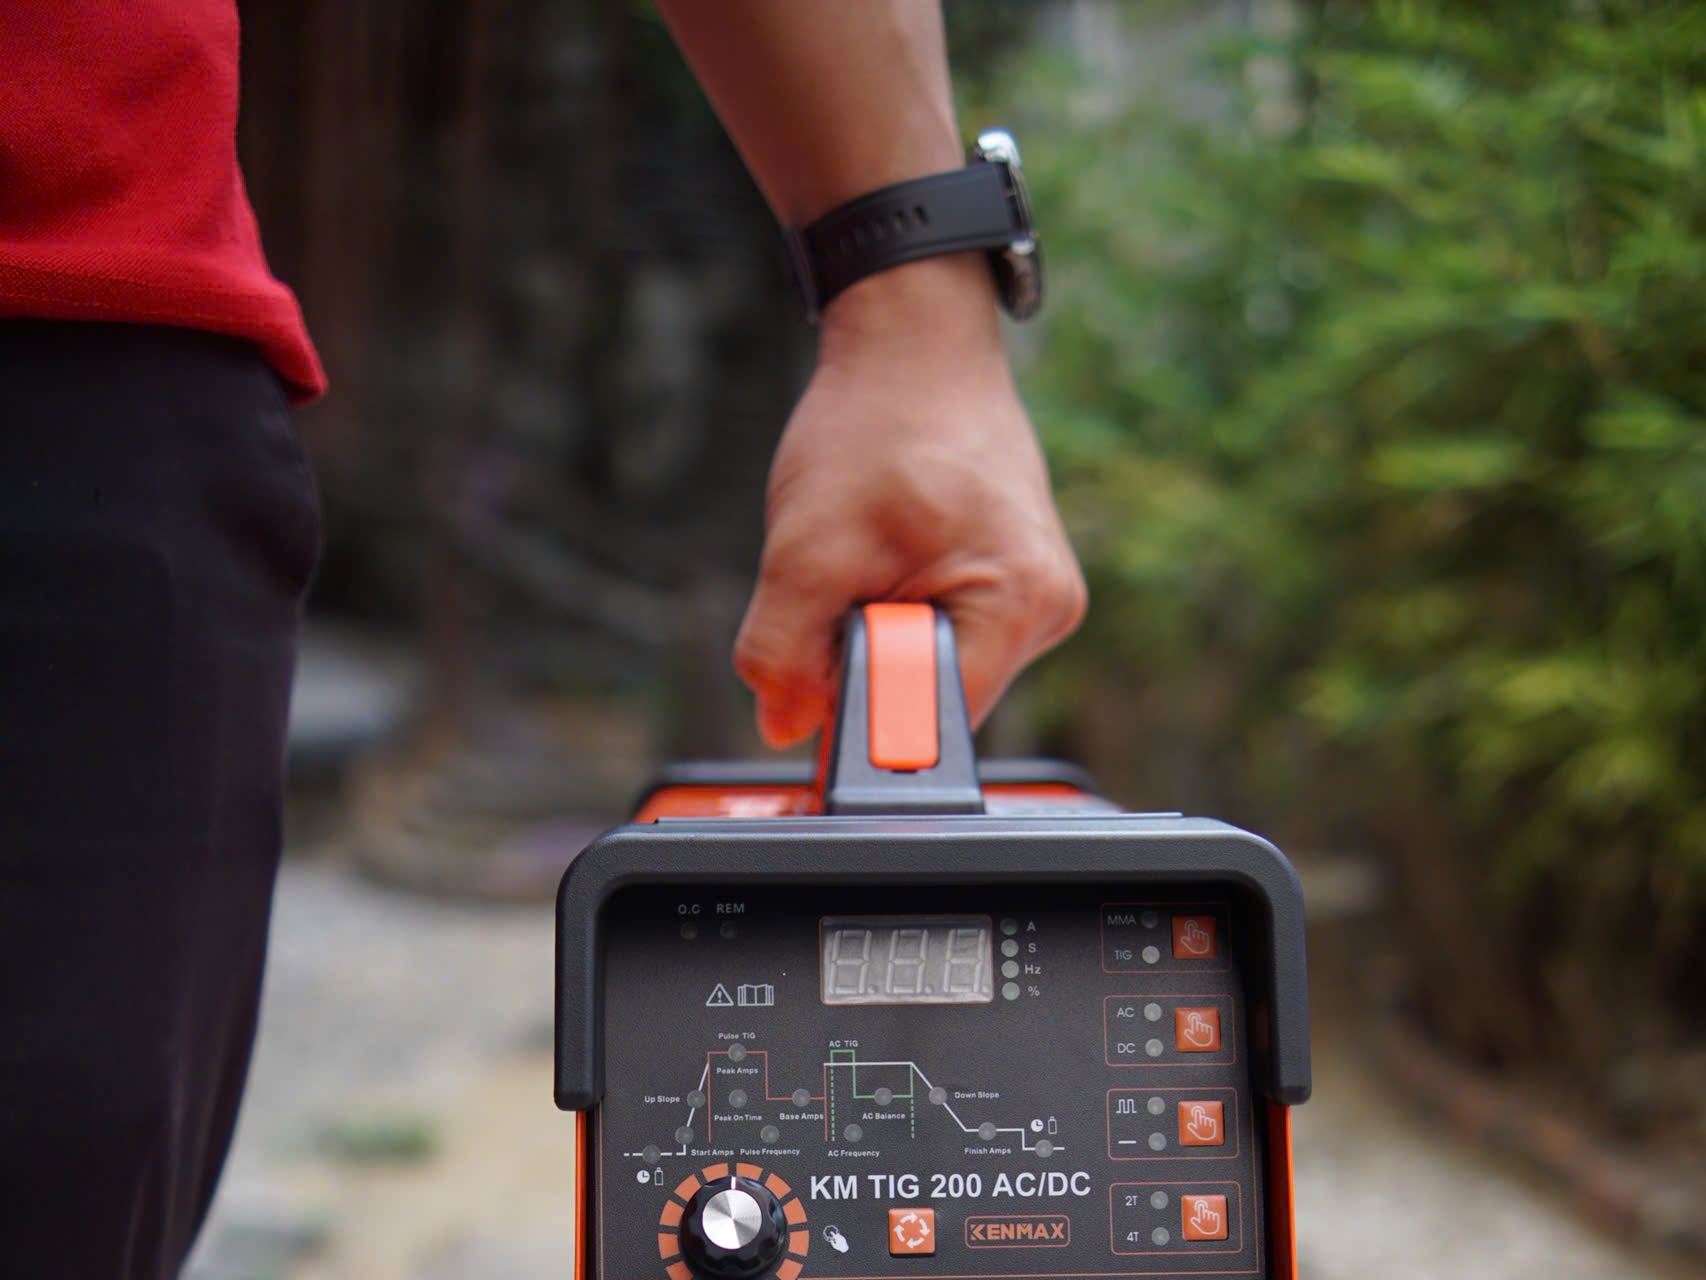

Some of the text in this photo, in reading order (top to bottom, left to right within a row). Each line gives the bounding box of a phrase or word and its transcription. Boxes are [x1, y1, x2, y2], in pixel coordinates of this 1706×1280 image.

[716, 902, 745, 914] REM
[1107, 914, 1136, 926] MMA
[1026, 922, 1037, 932] A
[1027, 943, 1037, 953] S
[1114, 950, 1133, 961] TIG
[1024, 964, 1042, 975] Hz
[1027, 985, 1041, 997] %
[1116, 1007, 1135, 1018] AC
[718, 1032, 756, 1040] Pulse TIG
[828, 1040, 859, 1048] AC TIG
[1117, 1043, 1136, 1054] DC
[737, 1067, 759, 1075] Amps
[644, 1095, 681, 1104] Up Slope
[954, 1091, 1000, 1100] Down Slope
[714, 1114, 763, 1122] Peak On Time
[801, 1112, 824, 1121] Amps
[862, 1112, 906, 1120] AC Balance
[712, 1149, 735, 1157] Amps
[740, 1148, 800, 1157] Pulse Frequency
[828, 1149, 880, 1159] AC Frequency
[964, 1147, 1012, 1156] Finish Amps
[810, 1171, 1091, 1200] KM TIG 200 AC/DC
[1125, 1195, 1138, 1207] 2T
[969, 1221, 1065, 1241] KENMAX
[1126, 1231, 1139, 1242] 4T
